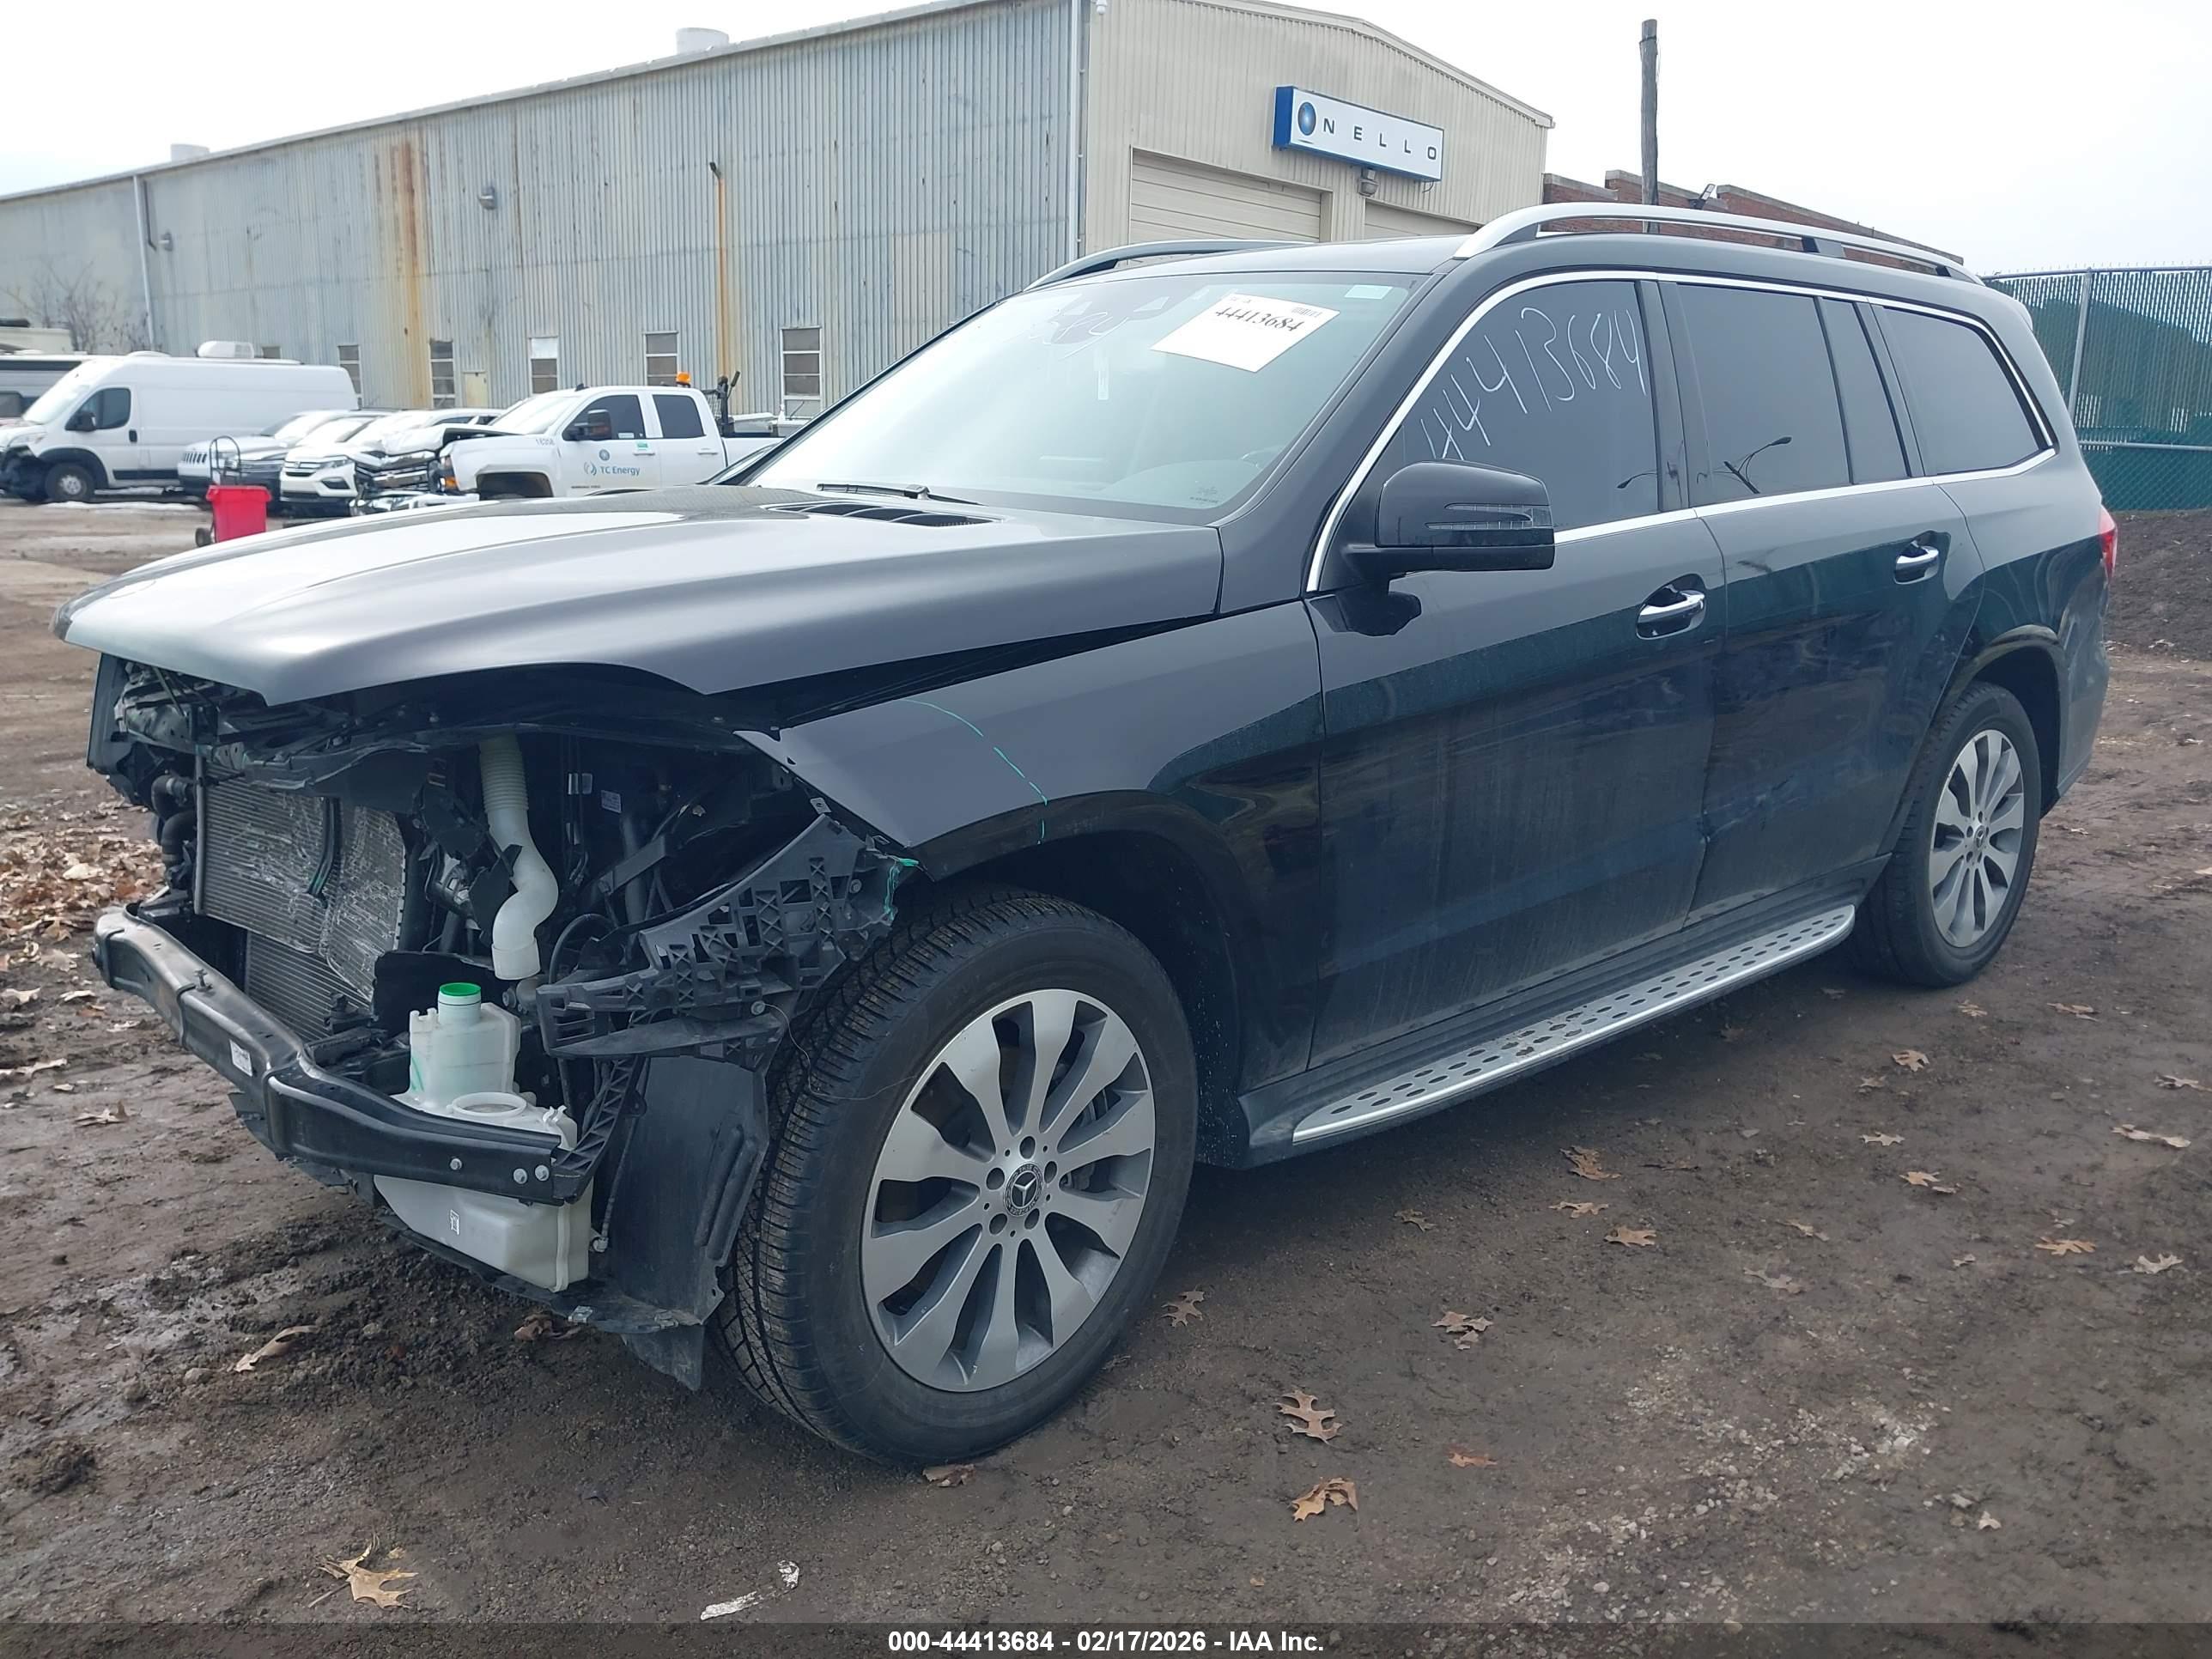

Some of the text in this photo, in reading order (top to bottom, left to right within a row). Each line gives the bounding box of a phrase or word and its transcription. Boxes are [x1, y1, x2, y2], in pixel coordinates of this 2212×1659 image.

[1215, 307, 1304, 331] 44413684
[1420, 307, 1647, 461] 44413684
[600, 465, 641, 477] TC Energy
